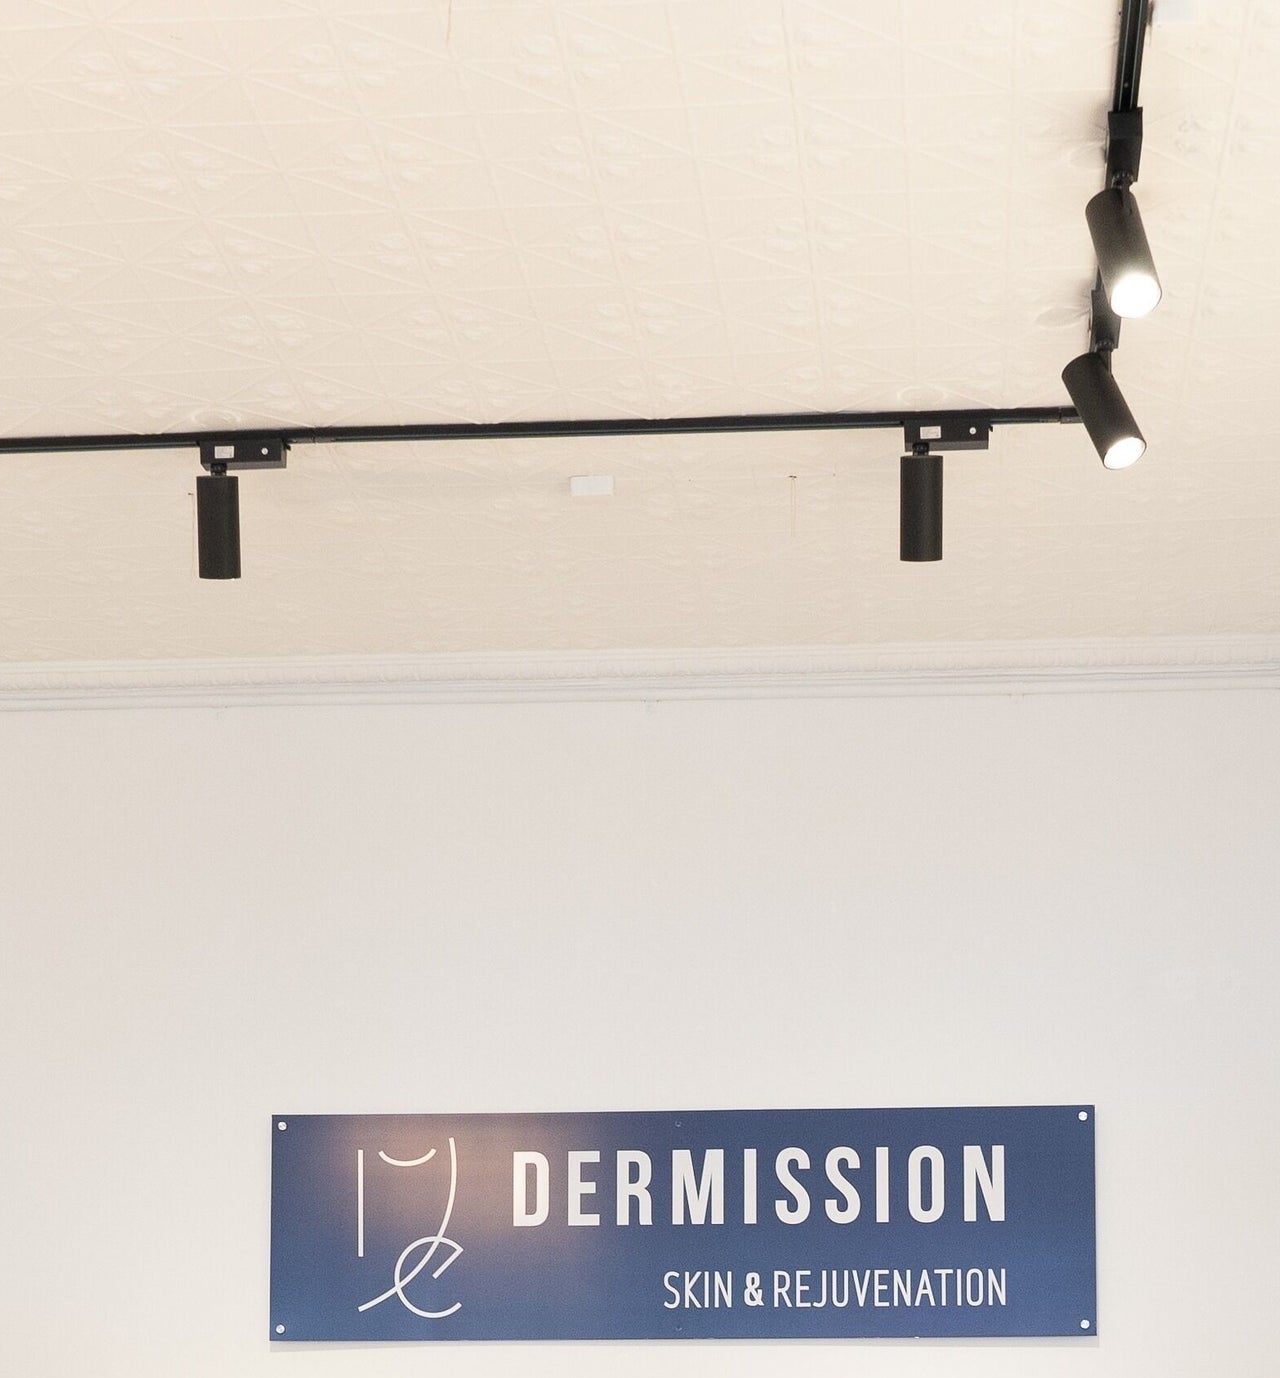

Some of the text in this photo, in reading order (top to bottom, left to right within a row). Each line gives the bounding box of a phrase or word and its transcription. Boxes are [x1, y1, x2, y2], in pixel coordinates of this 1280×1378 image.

[512, 1145, 1007, 1228] DERMISSION
[663, 1267, 1008, 1310] SKIN & REJUVENATION
